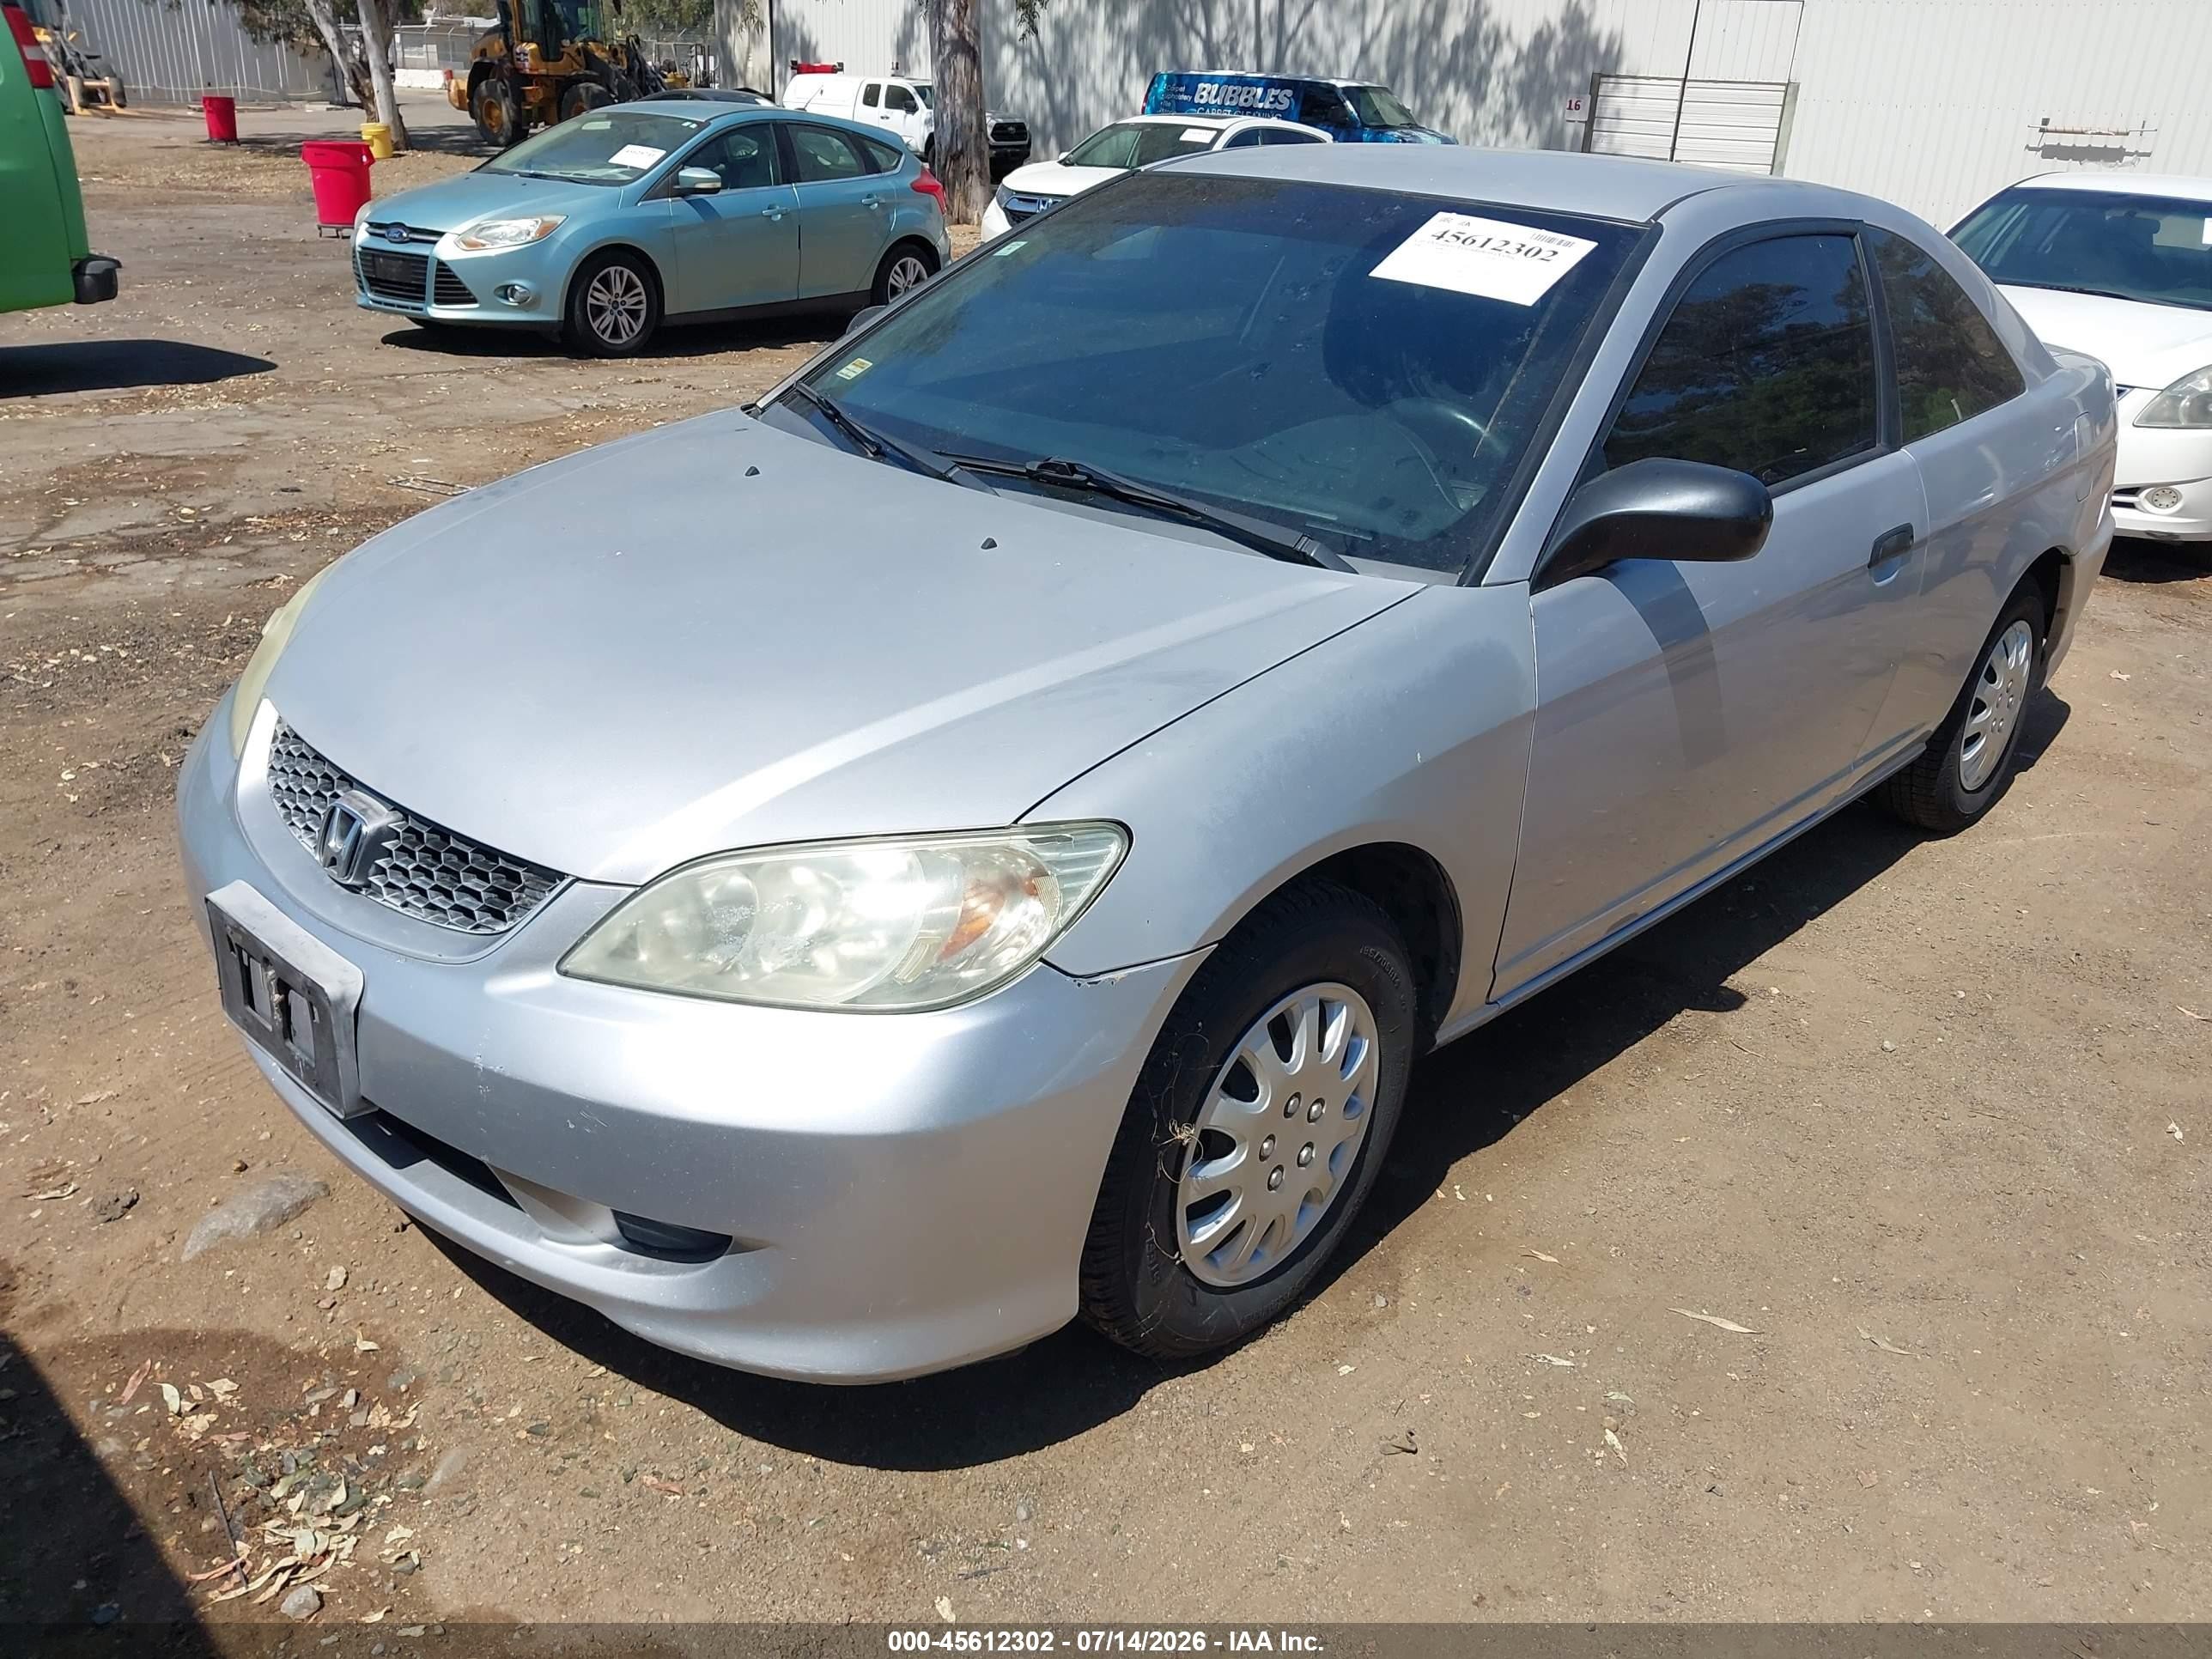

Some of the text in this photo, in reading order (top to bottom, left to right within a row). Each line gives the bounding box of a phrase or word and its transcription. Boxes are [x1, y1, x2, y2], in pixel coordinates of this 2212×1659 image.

[1194, 82, 1293, 111] BUBBLES
[1566, 99, 1582, 111] 16
[1431, 229, 1559, 262] 45612302
